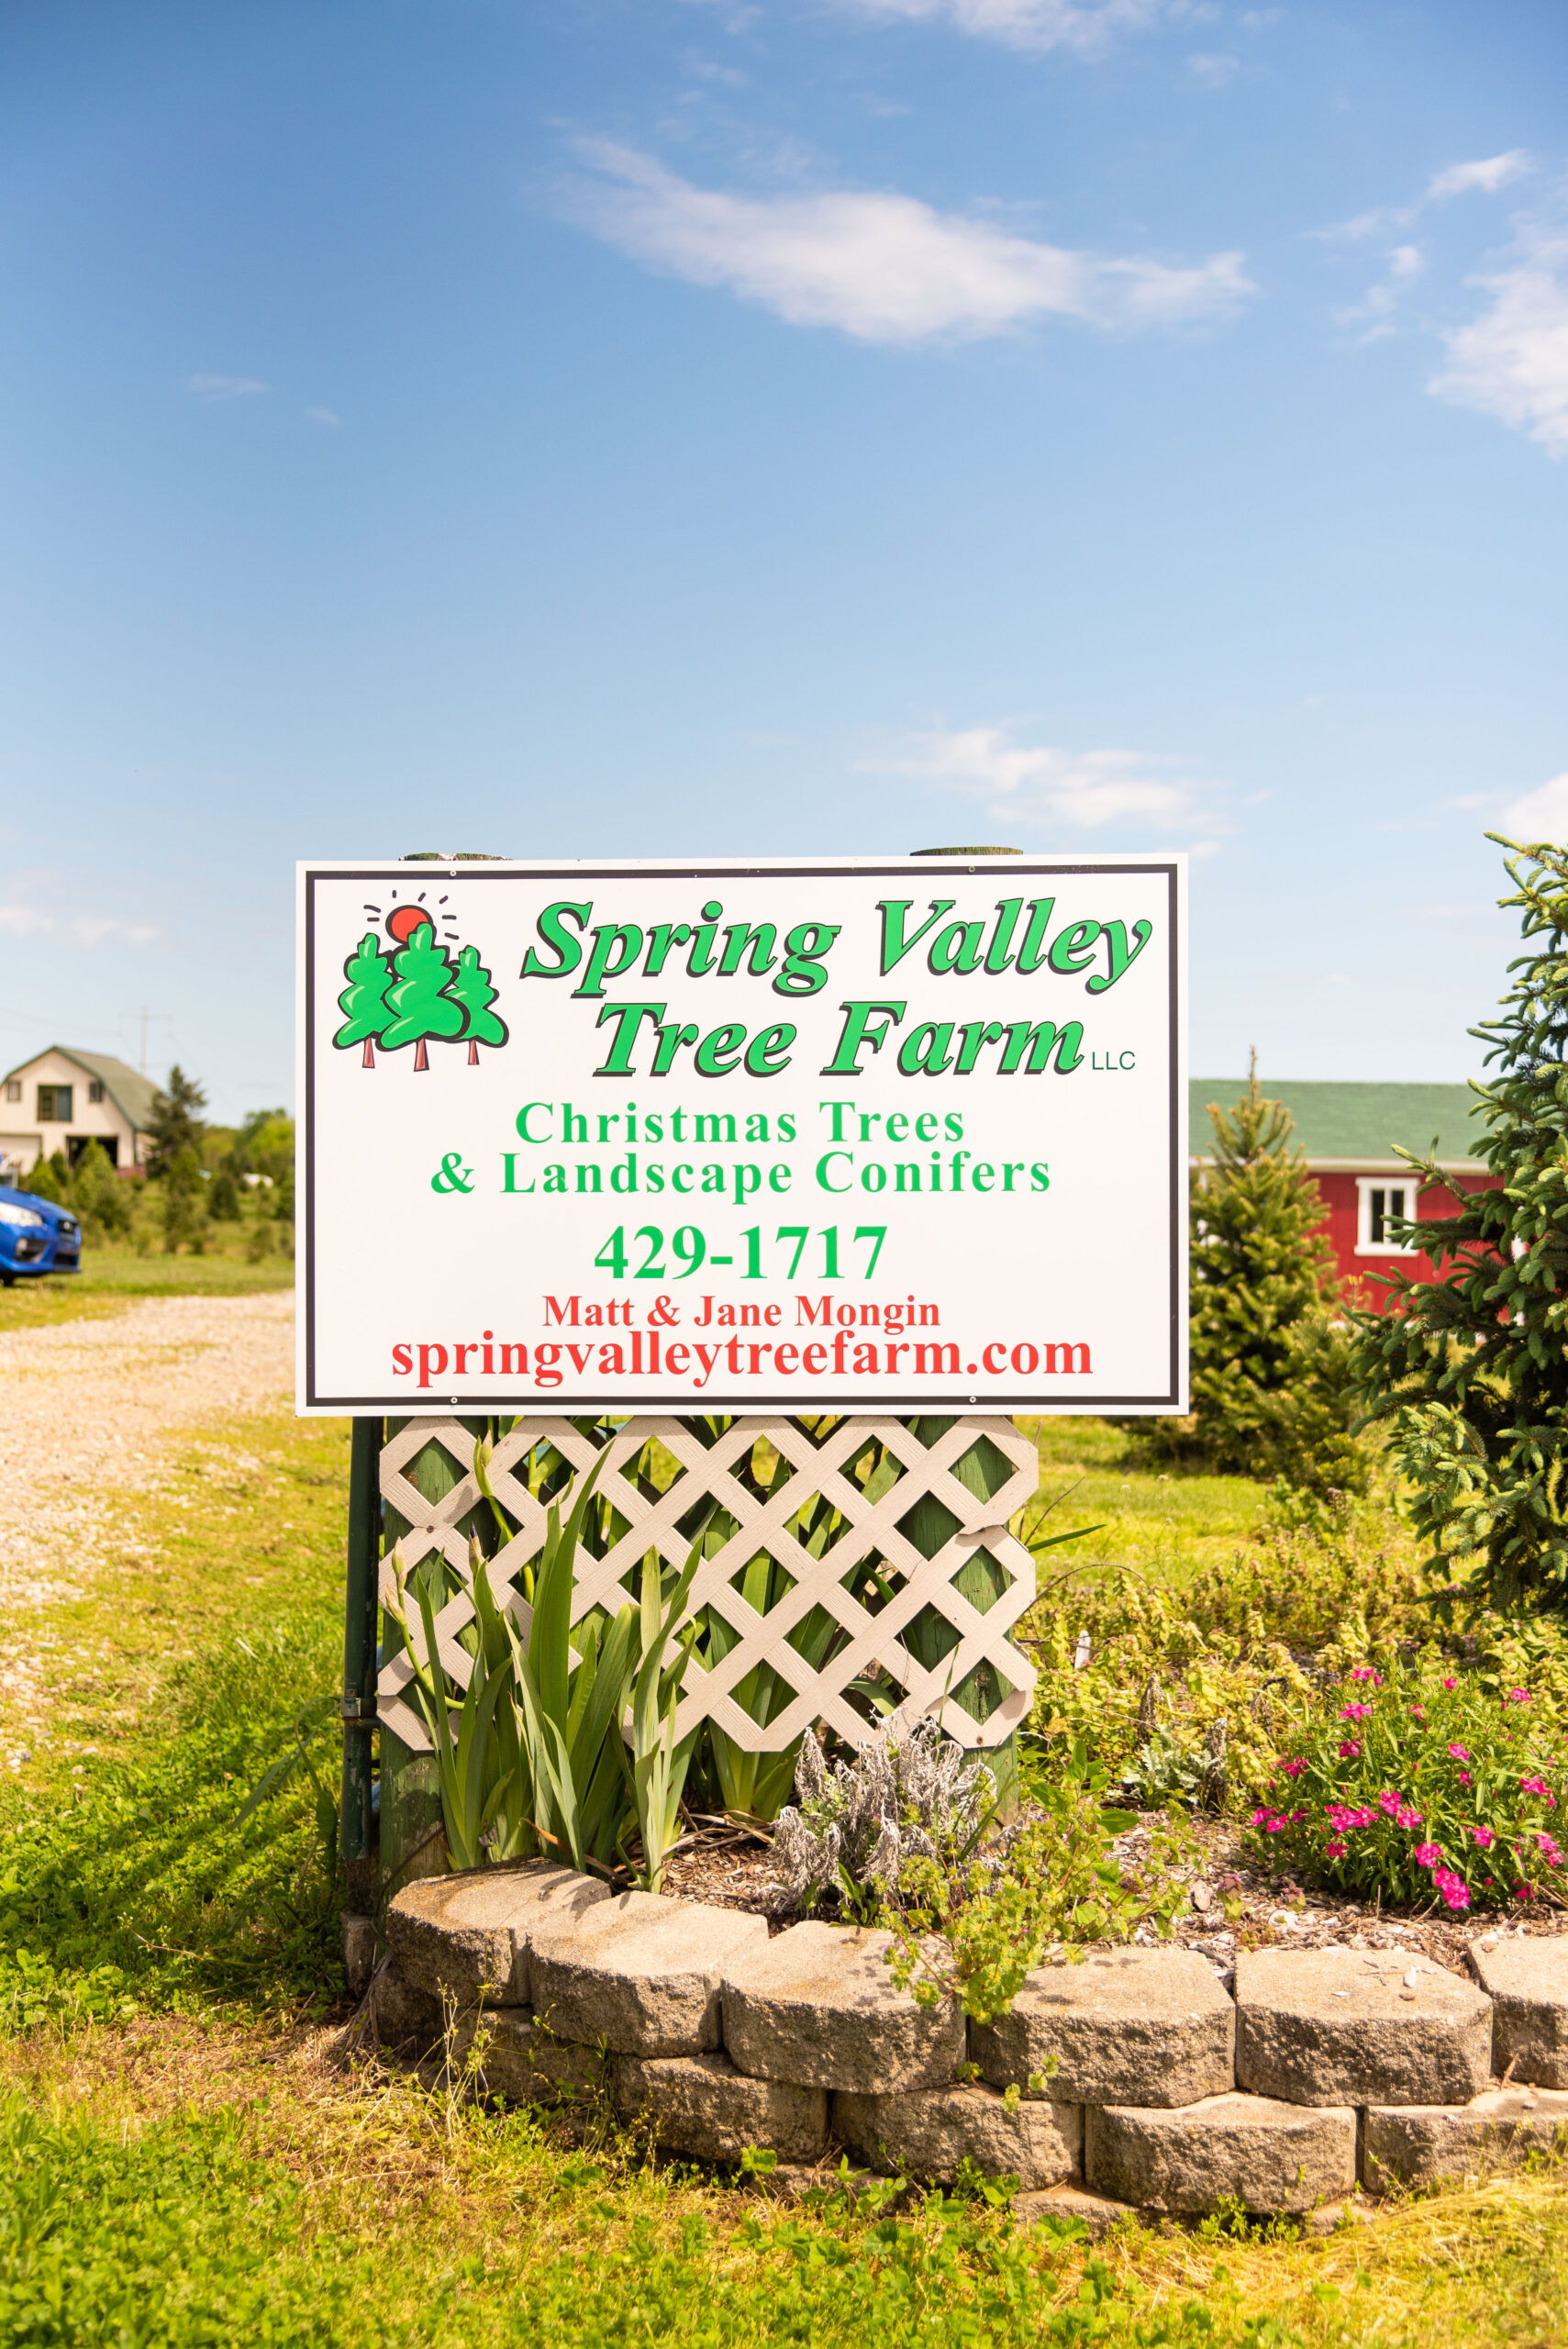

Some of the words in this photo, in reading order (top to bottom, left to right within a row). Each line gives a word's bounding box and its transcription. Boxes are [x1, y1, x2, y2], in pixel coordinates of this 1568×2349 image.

[519, 901, 842, 998] Spring
[875, 897, 1152, 995] Valley
[592, 1003, 797, 1078] Tree
[819, 1001, 1084, 1076] Farm
[1093, 1052, 1135, 1070] LLC
[516, 1102, 795, 1143] Christmas
[819, 1102, 963, 1141] Trees
[431, 1152, 475, 1194] &
[500, 1153, 791, 1205] Landscape
[816, 1151, 1050, 1193] Conifers
[595, 1226, 887, 1279] 429-1717
[543, 1296, 634, 1326] Matt
[648, 1296, 680, 1326] &
[694, 1296, 781, 1326] Jane
[795, 1295, 940, 1335] Mongin
[393, 1330, 1093, 1387] springvalleytreefarm.com
